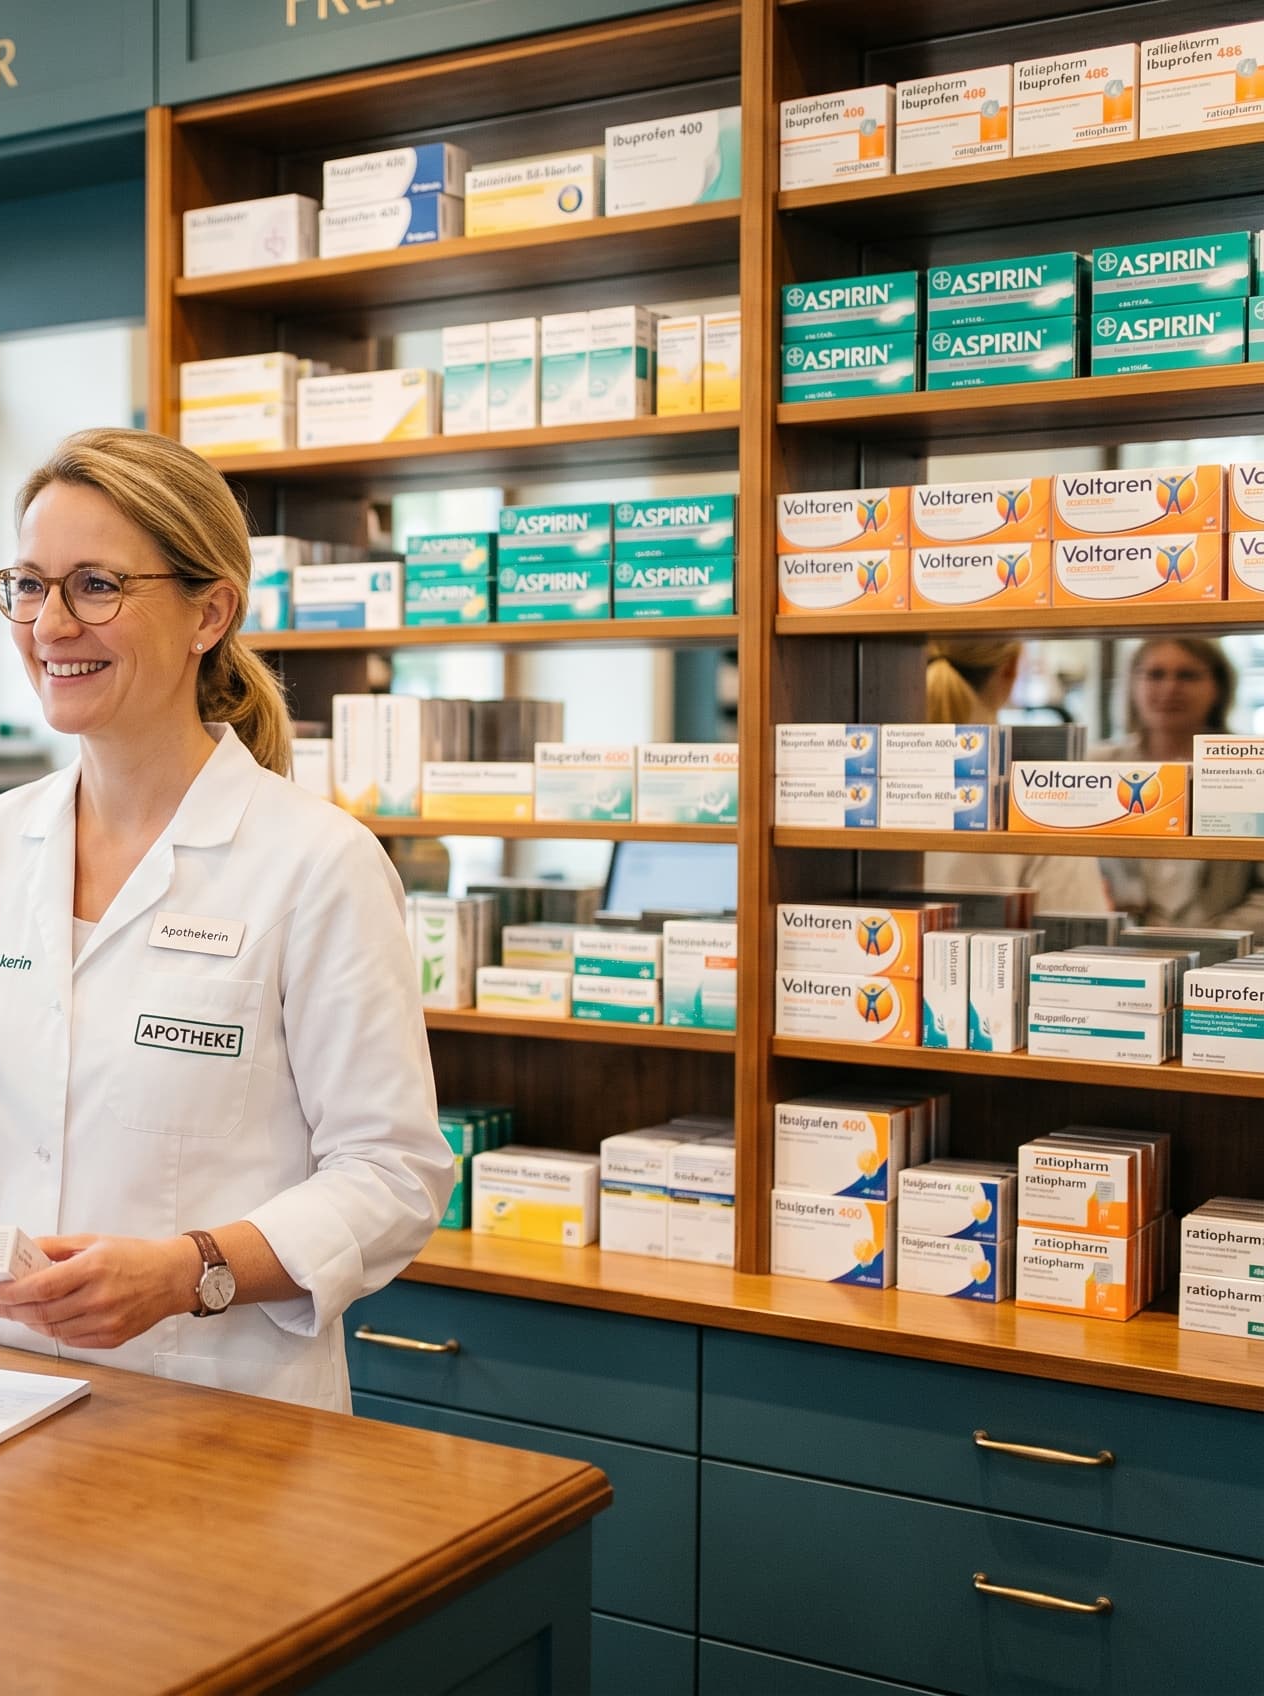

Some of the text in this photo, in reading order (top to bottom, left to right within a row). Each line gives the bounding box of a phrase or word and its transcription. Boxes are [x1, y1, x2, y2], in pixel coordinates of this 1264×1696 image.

[1146, 52, 1212, 71] Ibuprofen
[1018, 71, 1081, 91] Ibuprofen
[900, 92, 960, 110] Ibuprofen
[785, 111, 839, 129] Ibuprofen
[612, 121, 703, 148] Ibuprofen 400
[1116, 246, 1216, 277] ASPIRIN
[950, 266, 1042, 295] ASPIRIN
[803, 283, 890, 311] ASPIRIN
[1115, 312, 1215, 342] ASPIRIN
[949, 329, 1041, 357] ASPIRIN
[802, 344, 889, 371] ASPIRIN
[1062, 477, 1152, 497] Voltaren
[783, 499, 854, 516] Voltaren
[918, 489, 993, 507] Voltaren
[514, 513, 588, 535] ASPIRIN
[632, 504, 712, 528] ASPIRIN
[918, 552, 993, 569] Voltaren
[1062, 545, 1152, 563] Voltaren
[631, 565, 711, 588] ASPIRIN
[783, 559, 854, 575] Voltaren
[514, 571, 588, 593] ASPIRIN
[1020, 769, 1112, 789] Voltaren
[782, 911, 853, 930] Voltaren
[161, 925, 229, 942] Apothekerin
[781, 977, 852, 997] Voltaren
[141, 1023, 237, 1049] APOTHEKE
[841, 1119, 866, 1132] 400
[1035, 1155, 1109, 1173] ratiopharm
[1024, 1174, 1087, 1190] ratiopharm
[838, 1207, 862, 1220] 400
[1034, 1236, 1108, 1255] ratiopharm
[1185, 1227, 1262, 1246] ratiopharm
[1022, 1254, 1085, 1271] ratiopharm
[1185, 1283, 1263, 1302] ratiopharm
